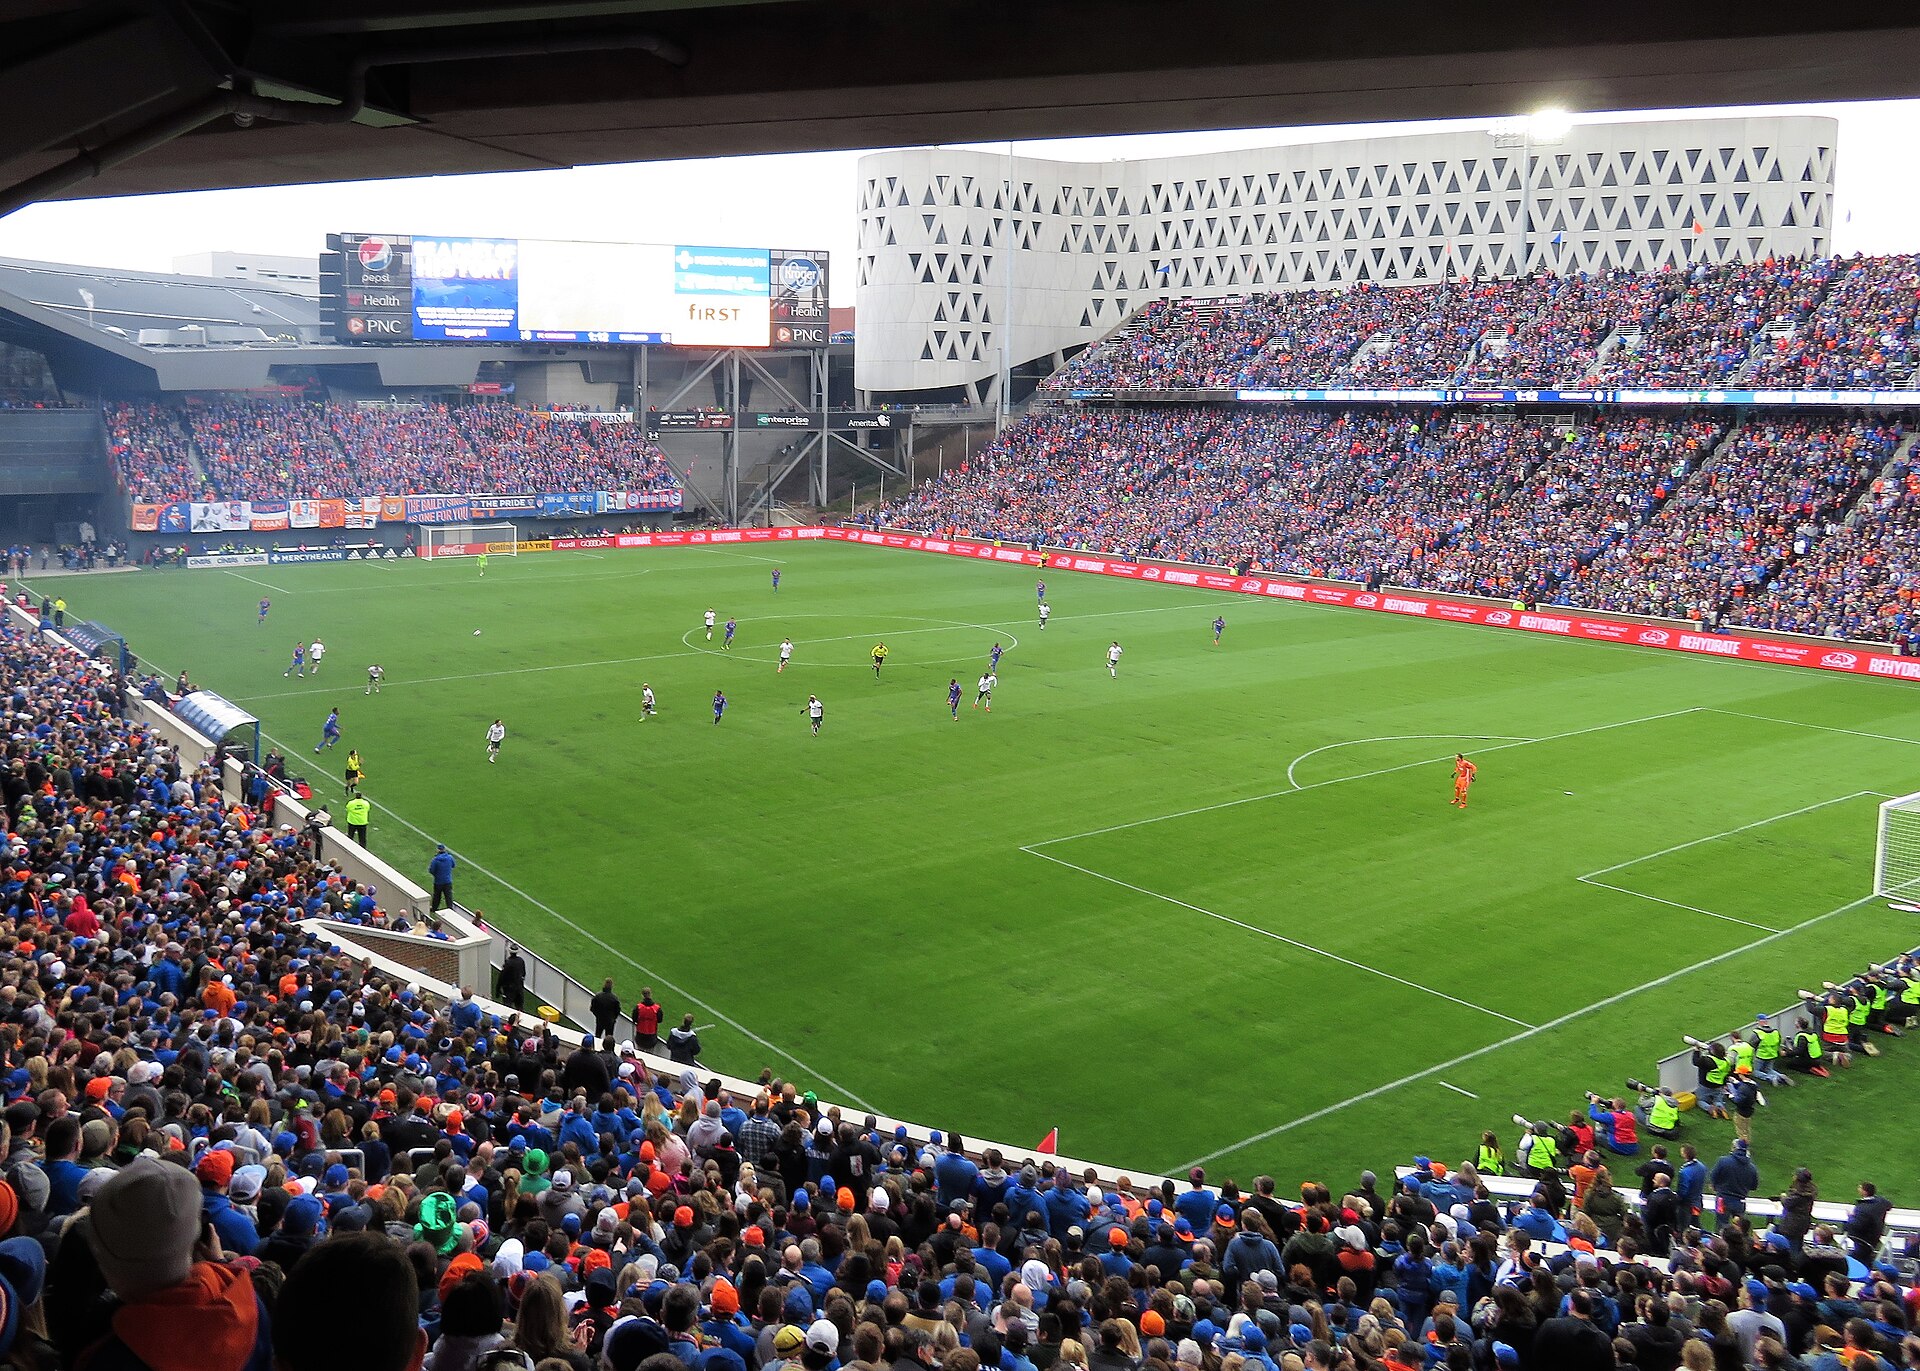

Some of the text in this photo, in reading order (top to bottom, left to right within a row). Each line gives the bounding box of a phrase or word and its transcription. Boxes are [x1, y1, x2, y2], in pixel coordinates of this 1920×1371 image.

[361, 273, 391, 284] pepsi
[784, 262, 817, 286] Kroger
[363, 294, 400, 306] Health
[790, 306, 822, 317] Health
[366, 319, 402, 334] PNC
[792, 328, 823, 342] PNC
[757, 416, 810, 425] enterprise
[847, 419, 879, 427] Ameritas
[406, 496, 469, 514] THE BAILEY SINGS
[480, 498, 526, 508] THE PRIDE
[407, 506, 469, 523] AS ONE FOR YOU
[534, 541, 550, 549] TIRE
[557, 540, 576, 548] Audi
[282, 552, 343, 562] MERCYHEALTH
[1519, 615, 1573, 633] REHYDRATE
[1580, 622, 1629, 633] RETHINK WHAT
[1679, 634, 1742, 655] REHYDRATE
[1752, 643, 1809, 656] RETHINK WHAT
[1758, 650, 1775, 658] YOU
